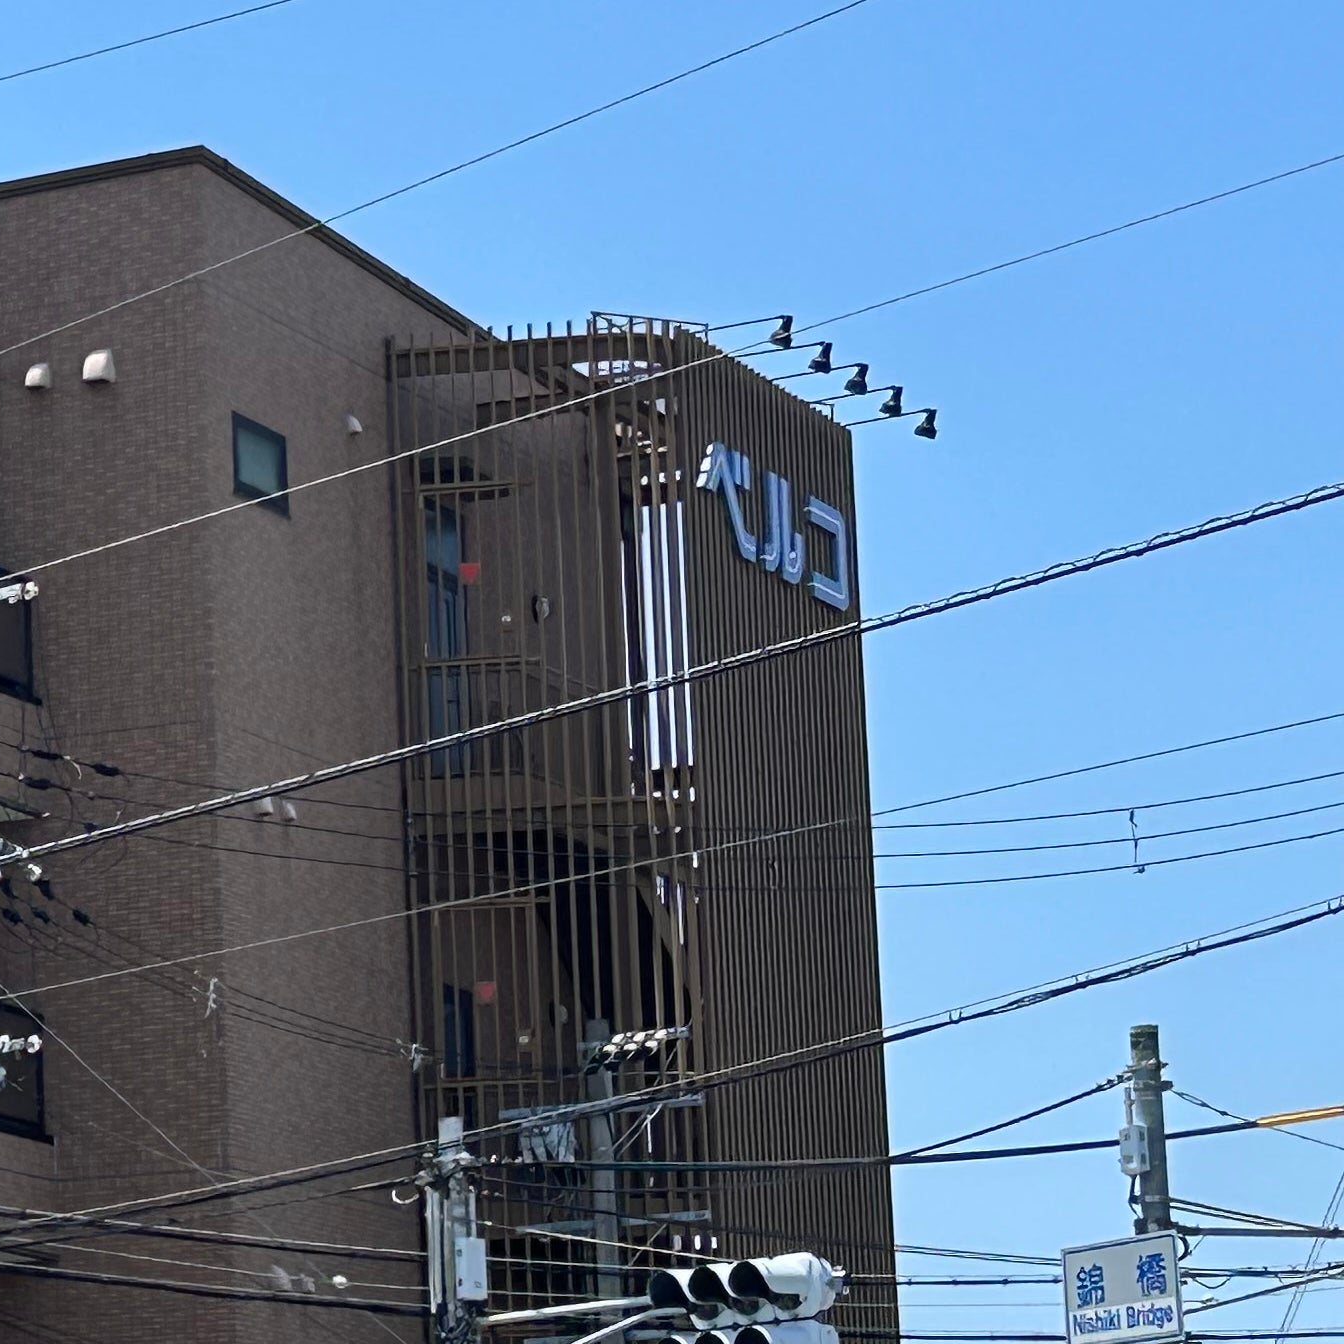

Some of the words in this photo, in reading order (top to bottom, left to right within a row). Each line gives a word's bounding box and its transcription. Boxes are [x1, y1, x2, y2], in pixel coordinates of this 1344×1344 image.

[696, 440, 849, 612] ベルコ
[1073, 1307, 1122, 1337] Nishiki
[1126, 1302, 1174, 1329] Bridge
